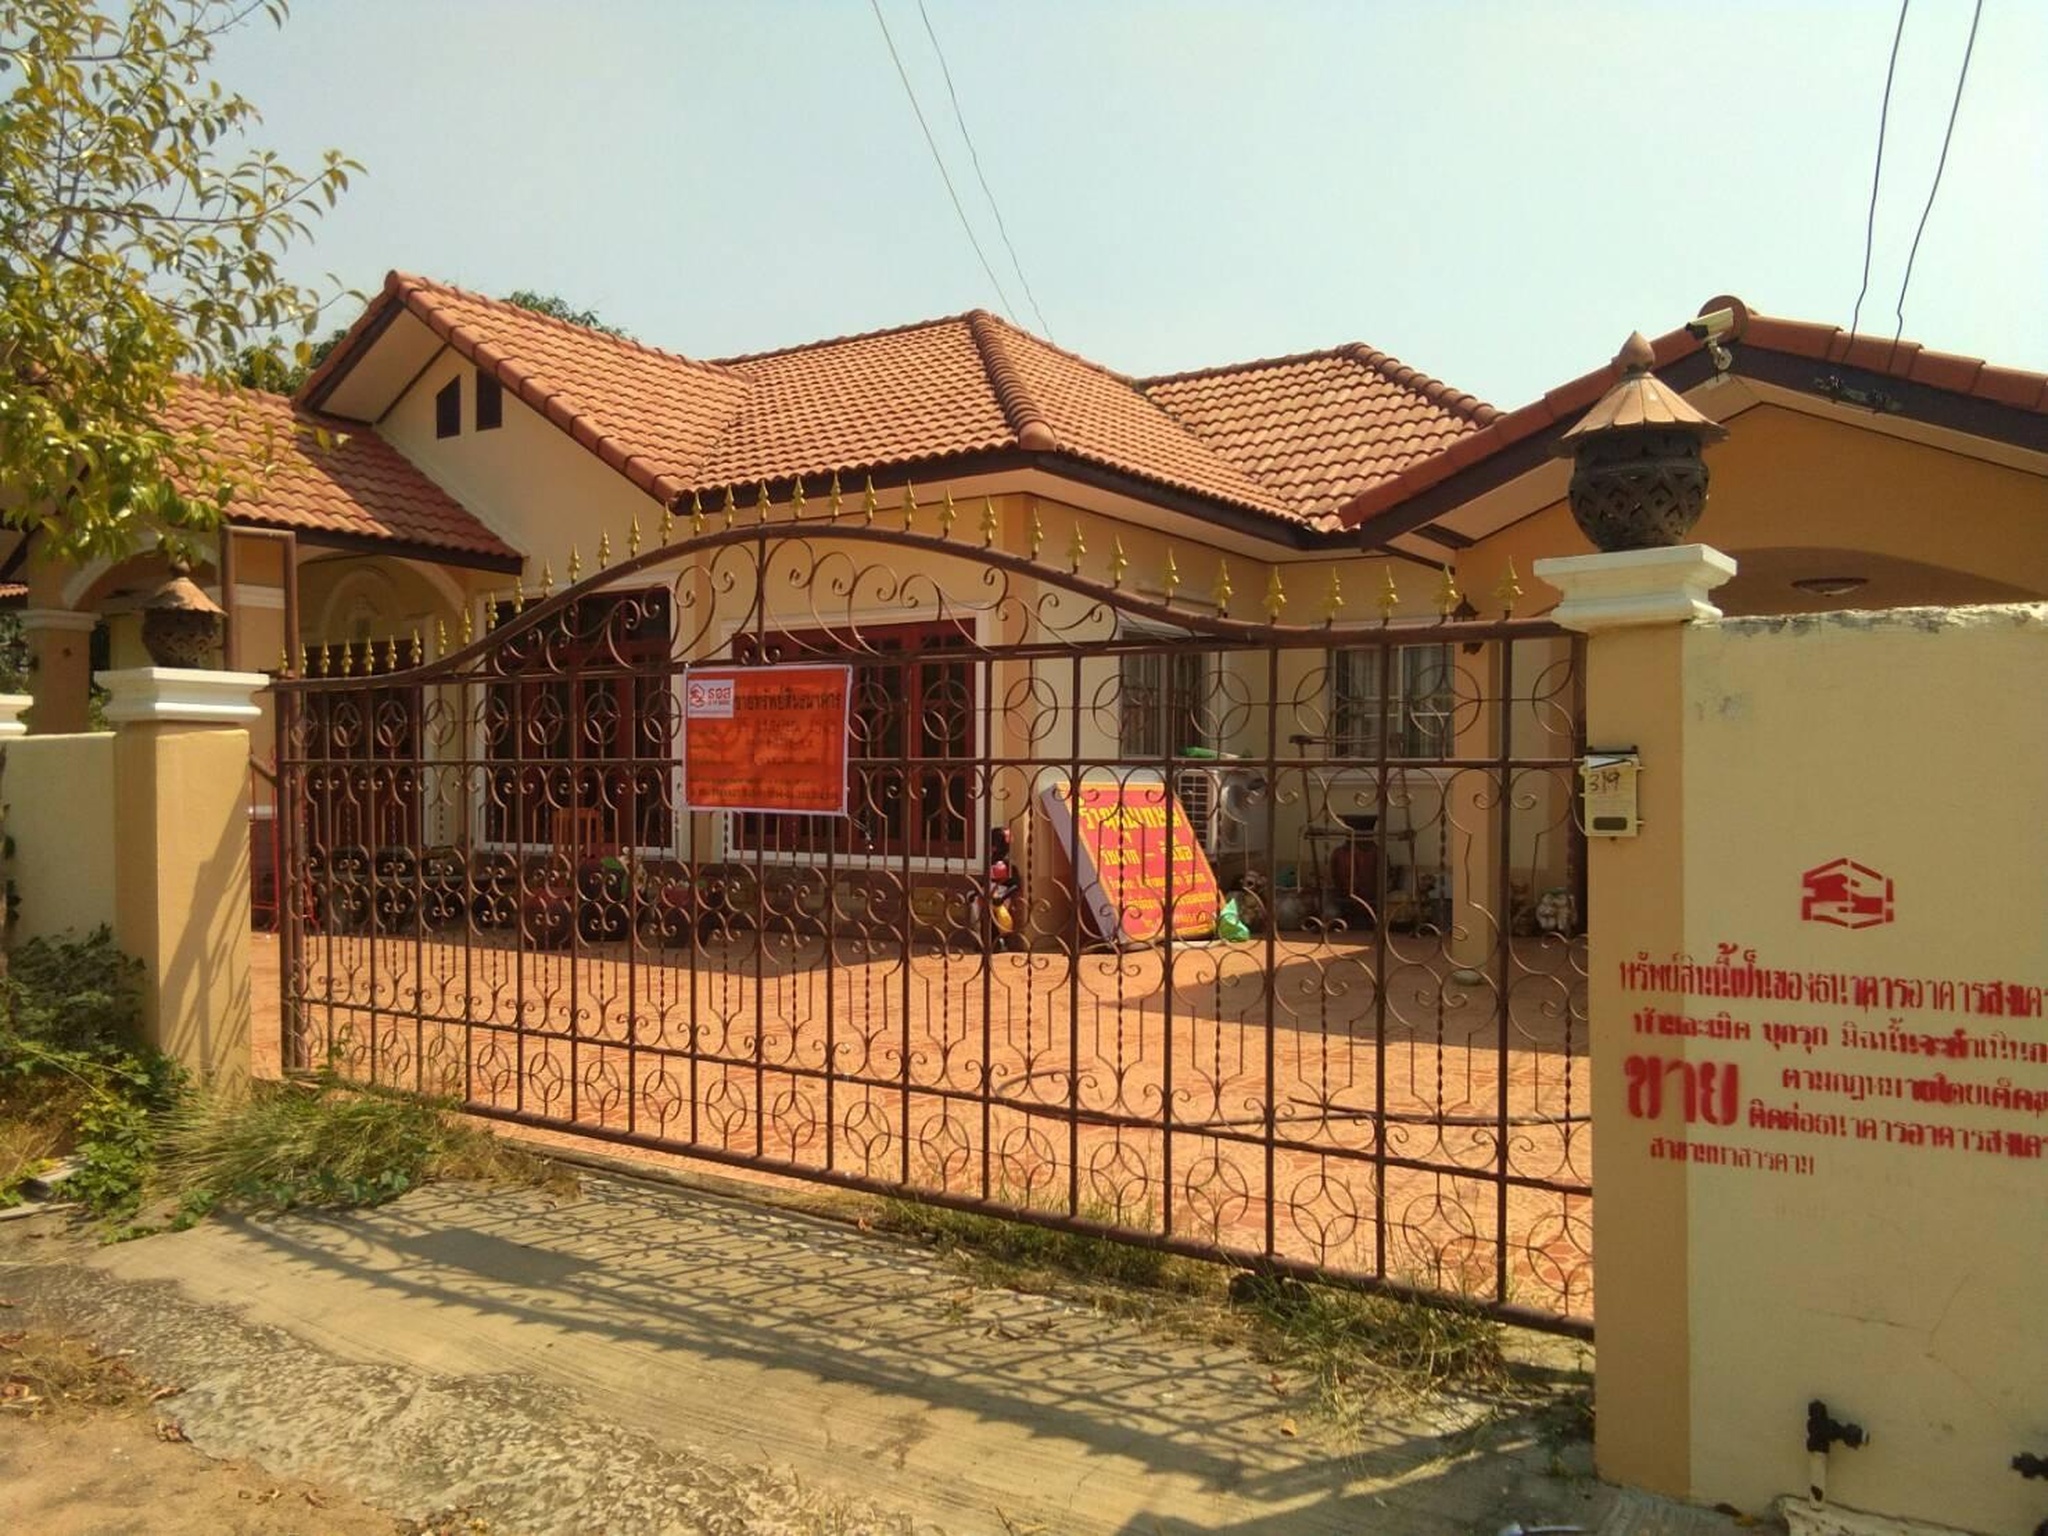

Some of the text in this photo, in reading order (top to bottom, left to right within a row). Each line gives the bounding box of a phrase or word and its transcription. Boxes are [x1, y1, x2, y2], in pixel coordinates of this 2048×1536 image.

[1763, 1021, 1829, 1054] บุกรุก
[1623, 1054, 1739, 1127] ขาย
[1650, 1136, 1815, 1175] สาขามหาสารคาม
